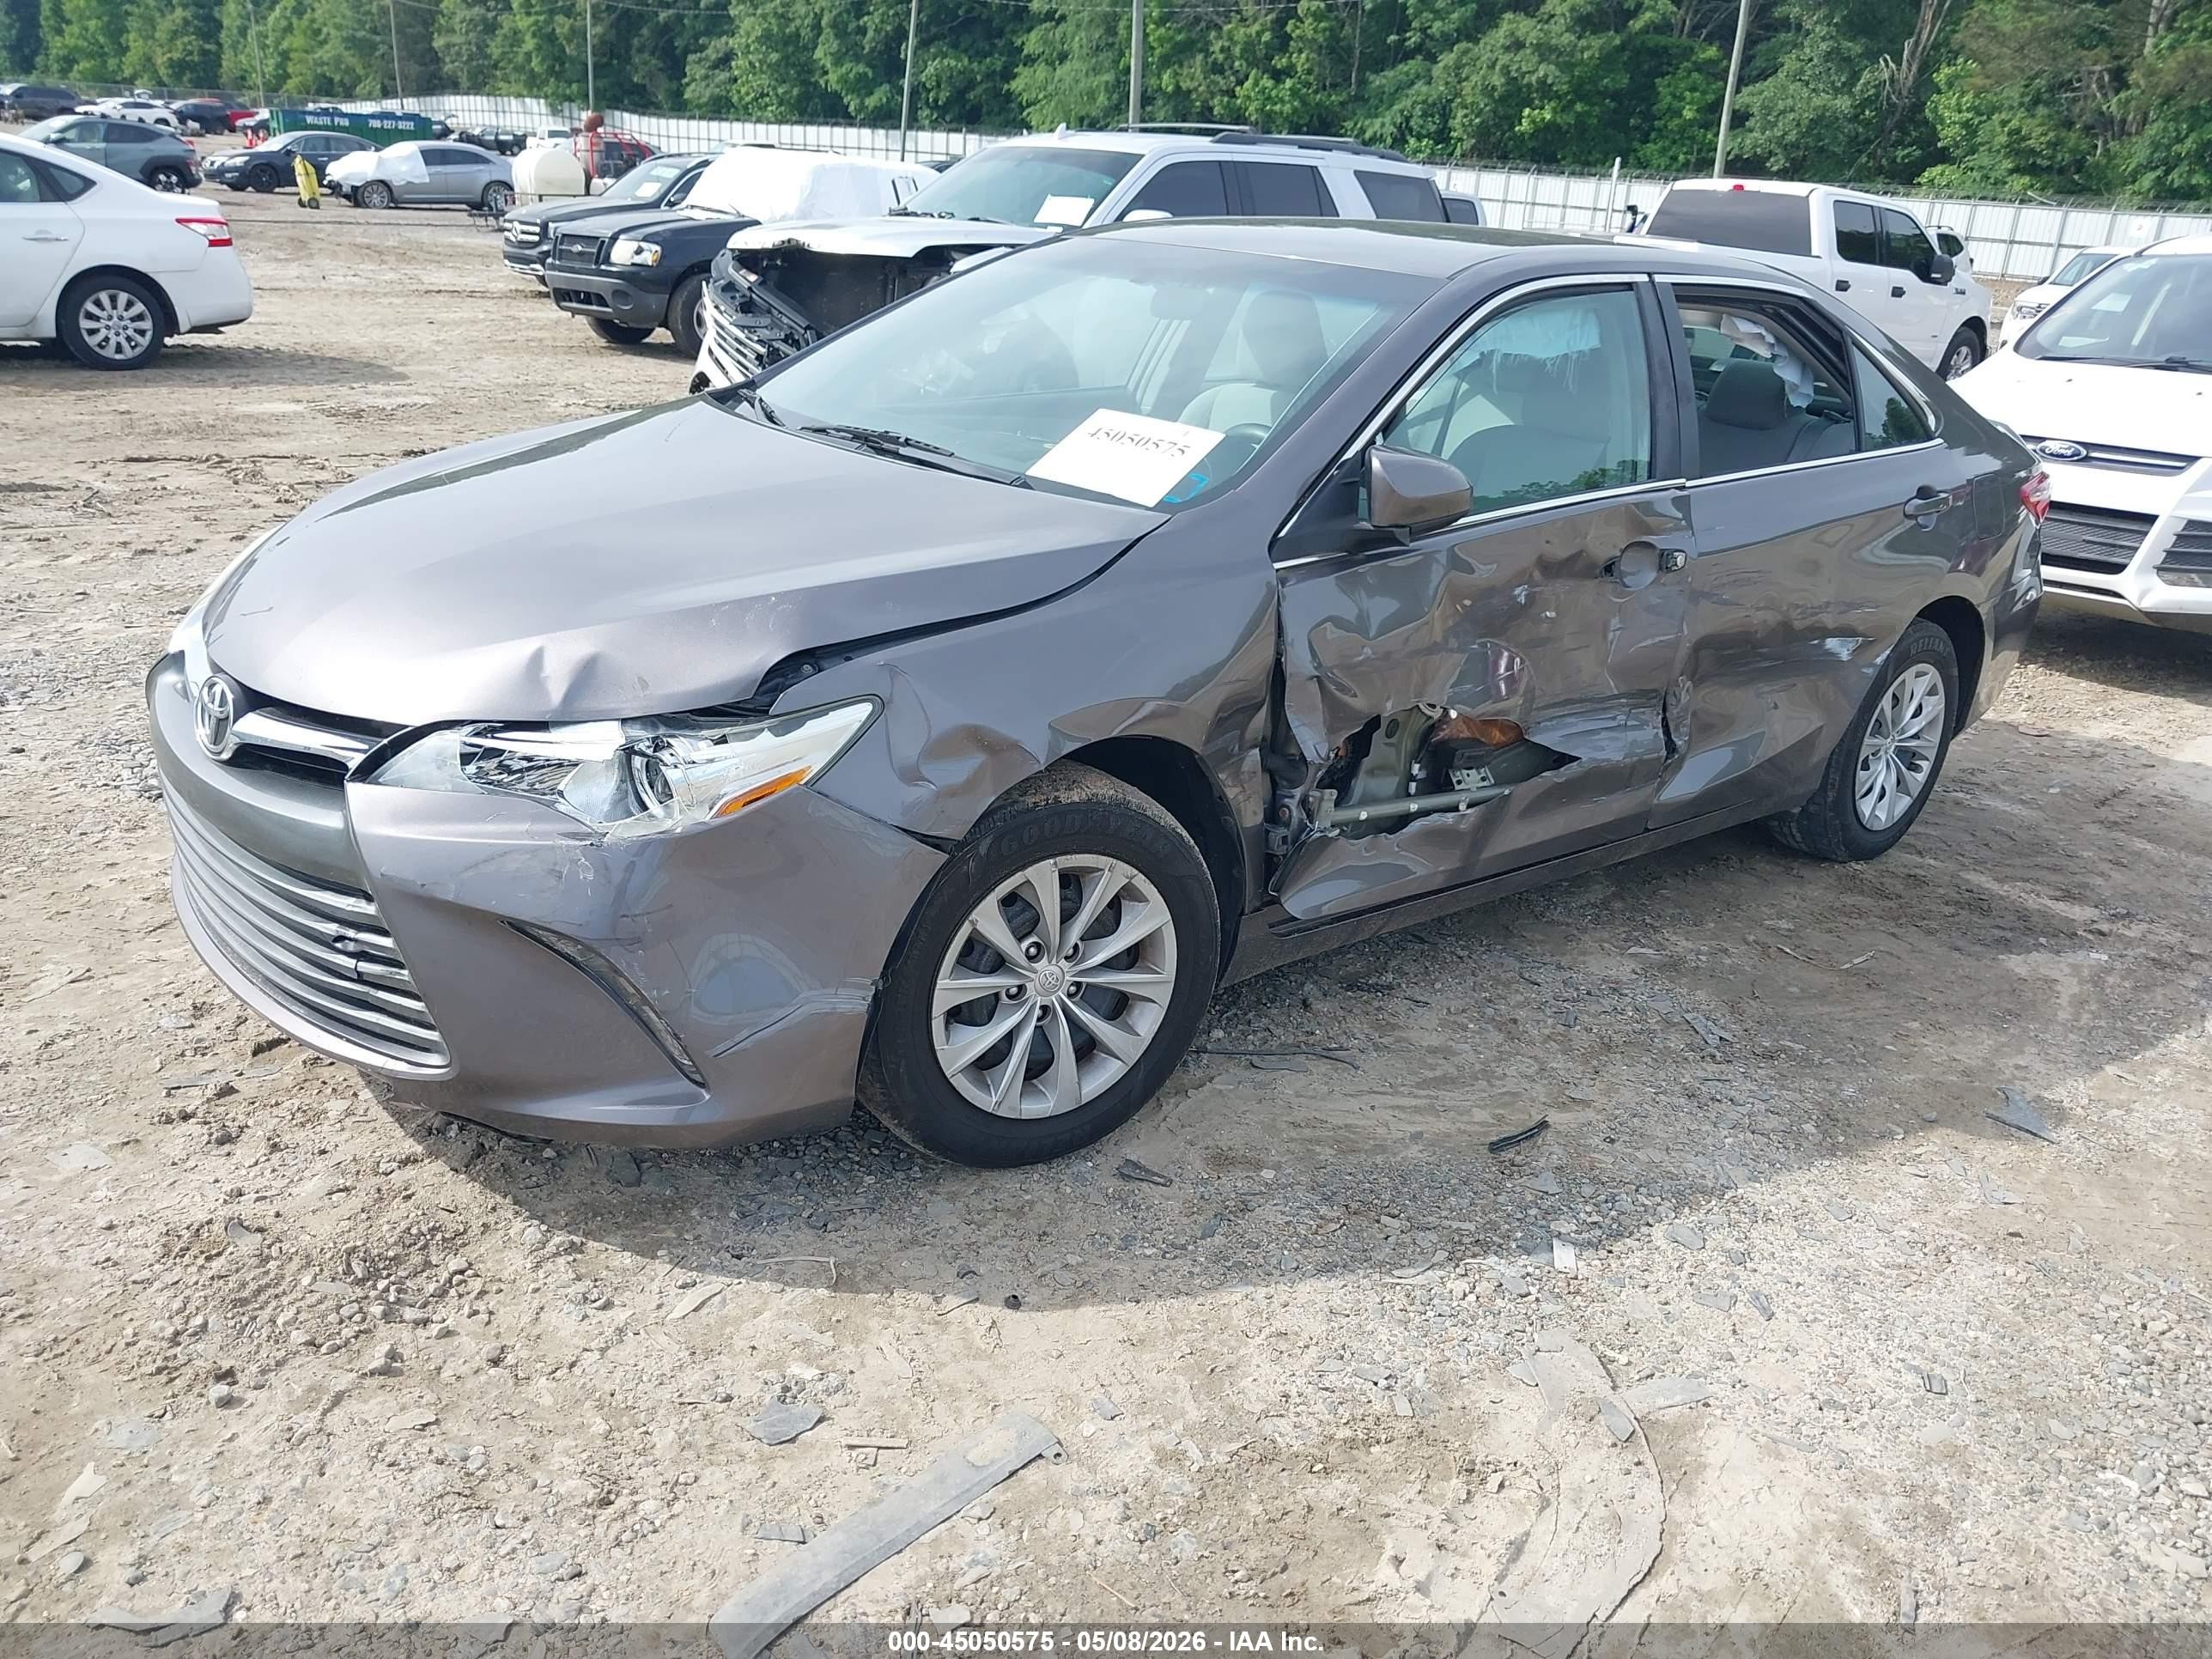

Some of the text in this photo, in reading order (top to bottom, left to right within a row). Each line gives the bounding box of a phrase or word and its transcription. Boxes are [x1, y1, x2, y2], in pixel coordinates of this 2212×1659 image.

[306, 115, 349, 126] WASTE PRO
[1087, 428, 1192, 458] 45050575
[2045, 443, 2075, 457] Ford
